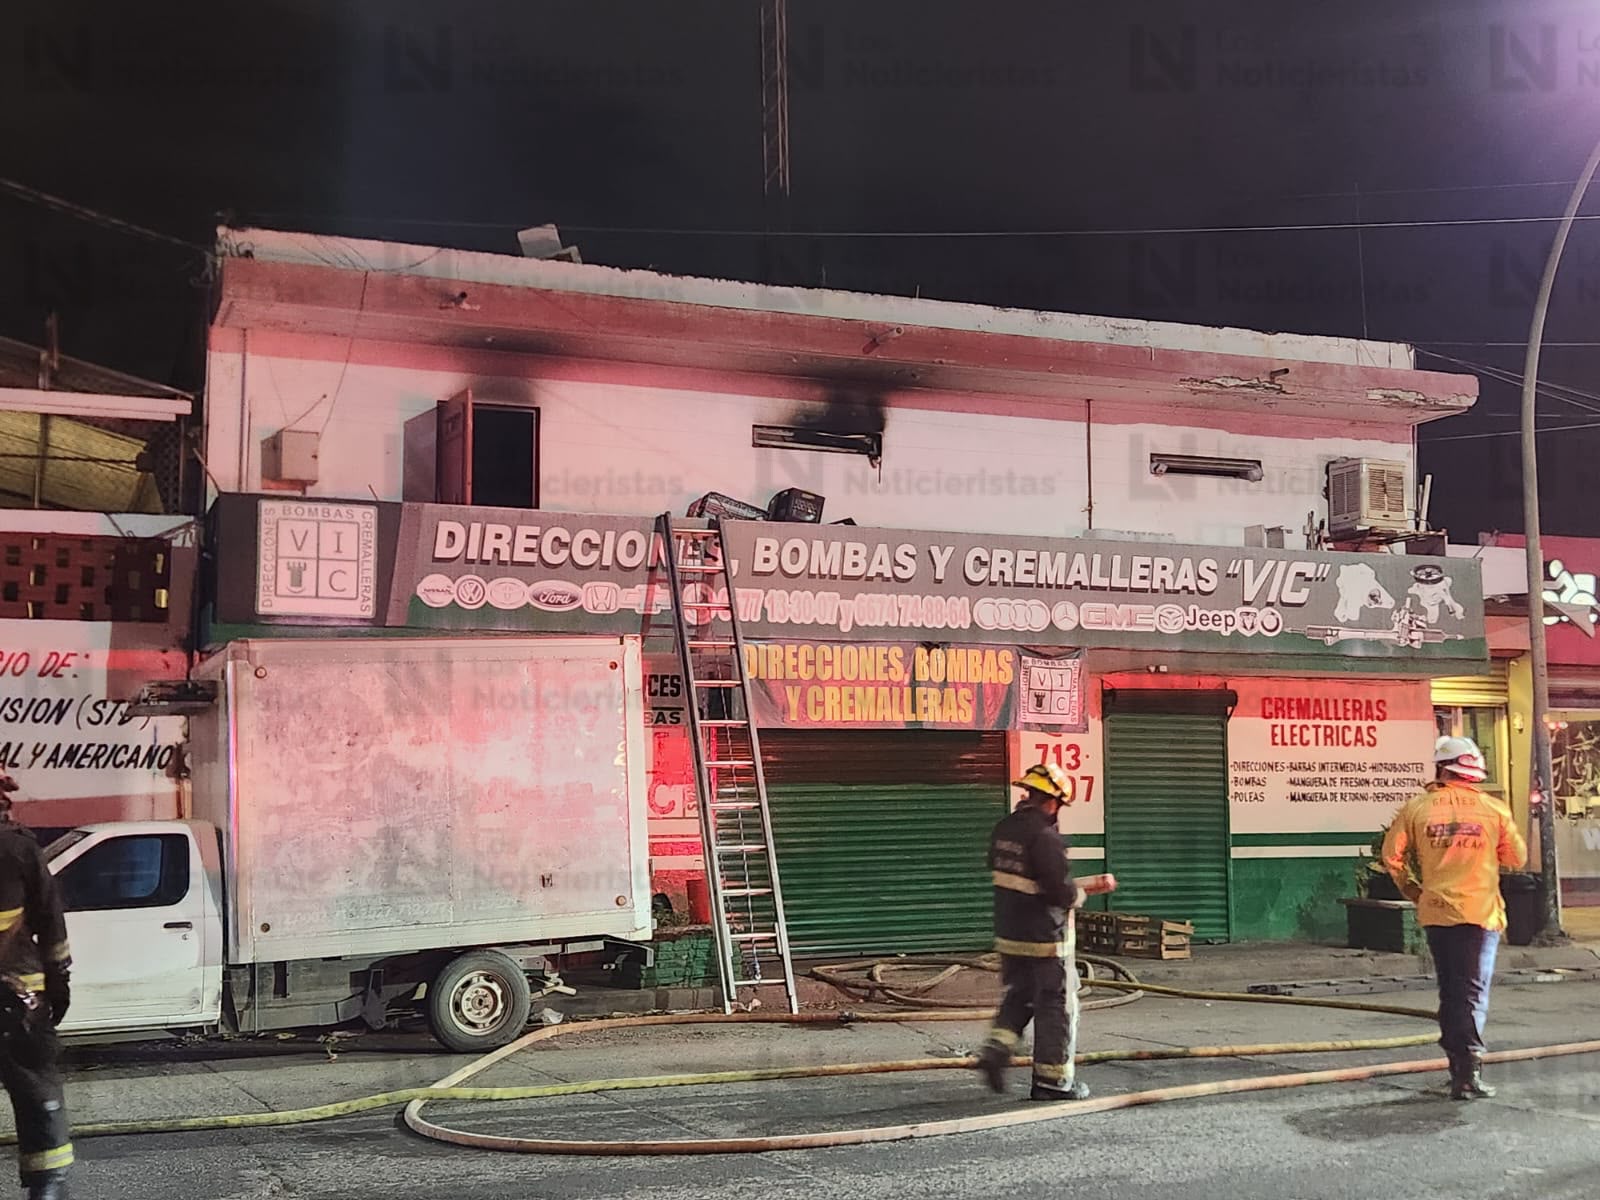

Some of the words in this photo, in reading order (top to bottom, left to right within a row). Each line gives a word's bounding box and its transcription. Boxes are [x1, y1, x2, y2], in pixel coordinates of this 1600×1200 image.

[282, 506, 354, 519] BOMBAS
[262, 508, 275, 608] DIRECCIONES
[360, 511, 373, 612] CREMALLERAS
[752, 536, 918, 583] BOMBAS
[929, 545, 955, 583] Y
[964, 547, 1218, 594] CREMALLERAS
[539, 590, 571, 605] Ford
[1087, 603, 1152, 629] GMC
[1186, 607, 1236, 632] Jeep
[0, 651, 31, 678] IO
[914, 648, 1013, 685] BOMBAS
[786, 686, 801, 721] Y
[806, 687, 973, 723] CREMALLERAS
[1261, 696, 1388, 722] CREMALLERAS
[1271, 724, 1378, 748] ELECTRICAS
[43, 742, 173, 770] AMERICANO
